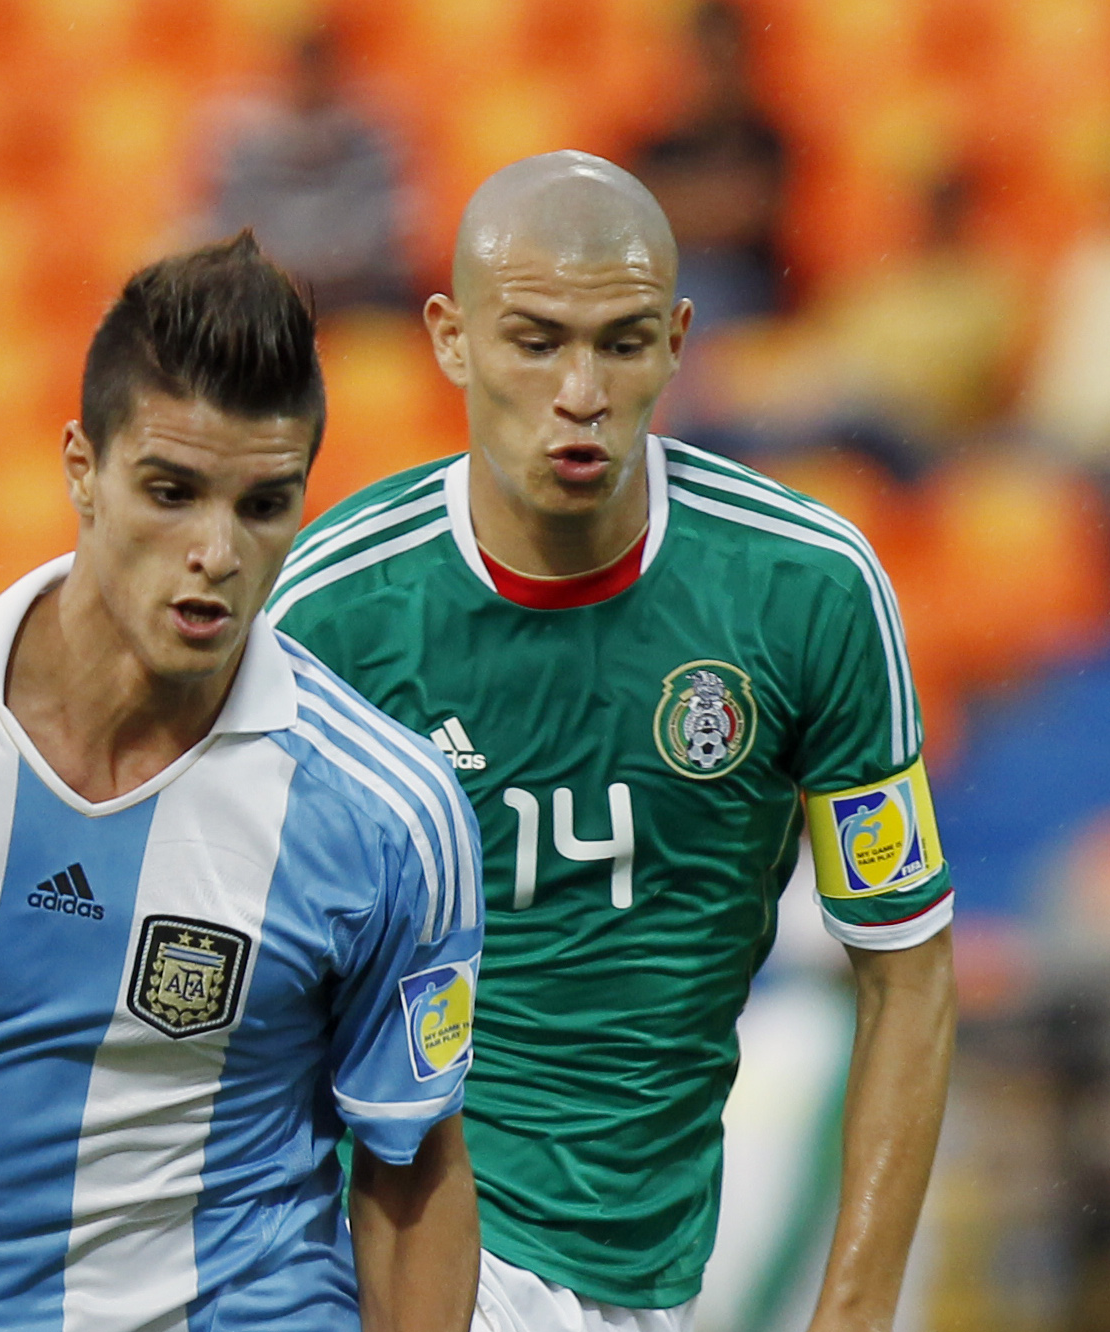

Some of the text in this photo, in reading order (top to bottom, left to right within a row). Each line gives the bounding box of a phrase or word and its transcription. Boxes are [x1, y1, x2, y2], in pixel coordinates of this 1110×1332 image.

[503, 783, 634, 909] 14
[871, 844, 894, 855] GAME
[27, 890, 105, 920] adidas
[165, 966, 205, 1002] AFA
[424, 1031, 437, 1041] MY
[438, 1024, 461, 1036] GAME
[425, 1031, 461, 1050] FAIR PLAY
